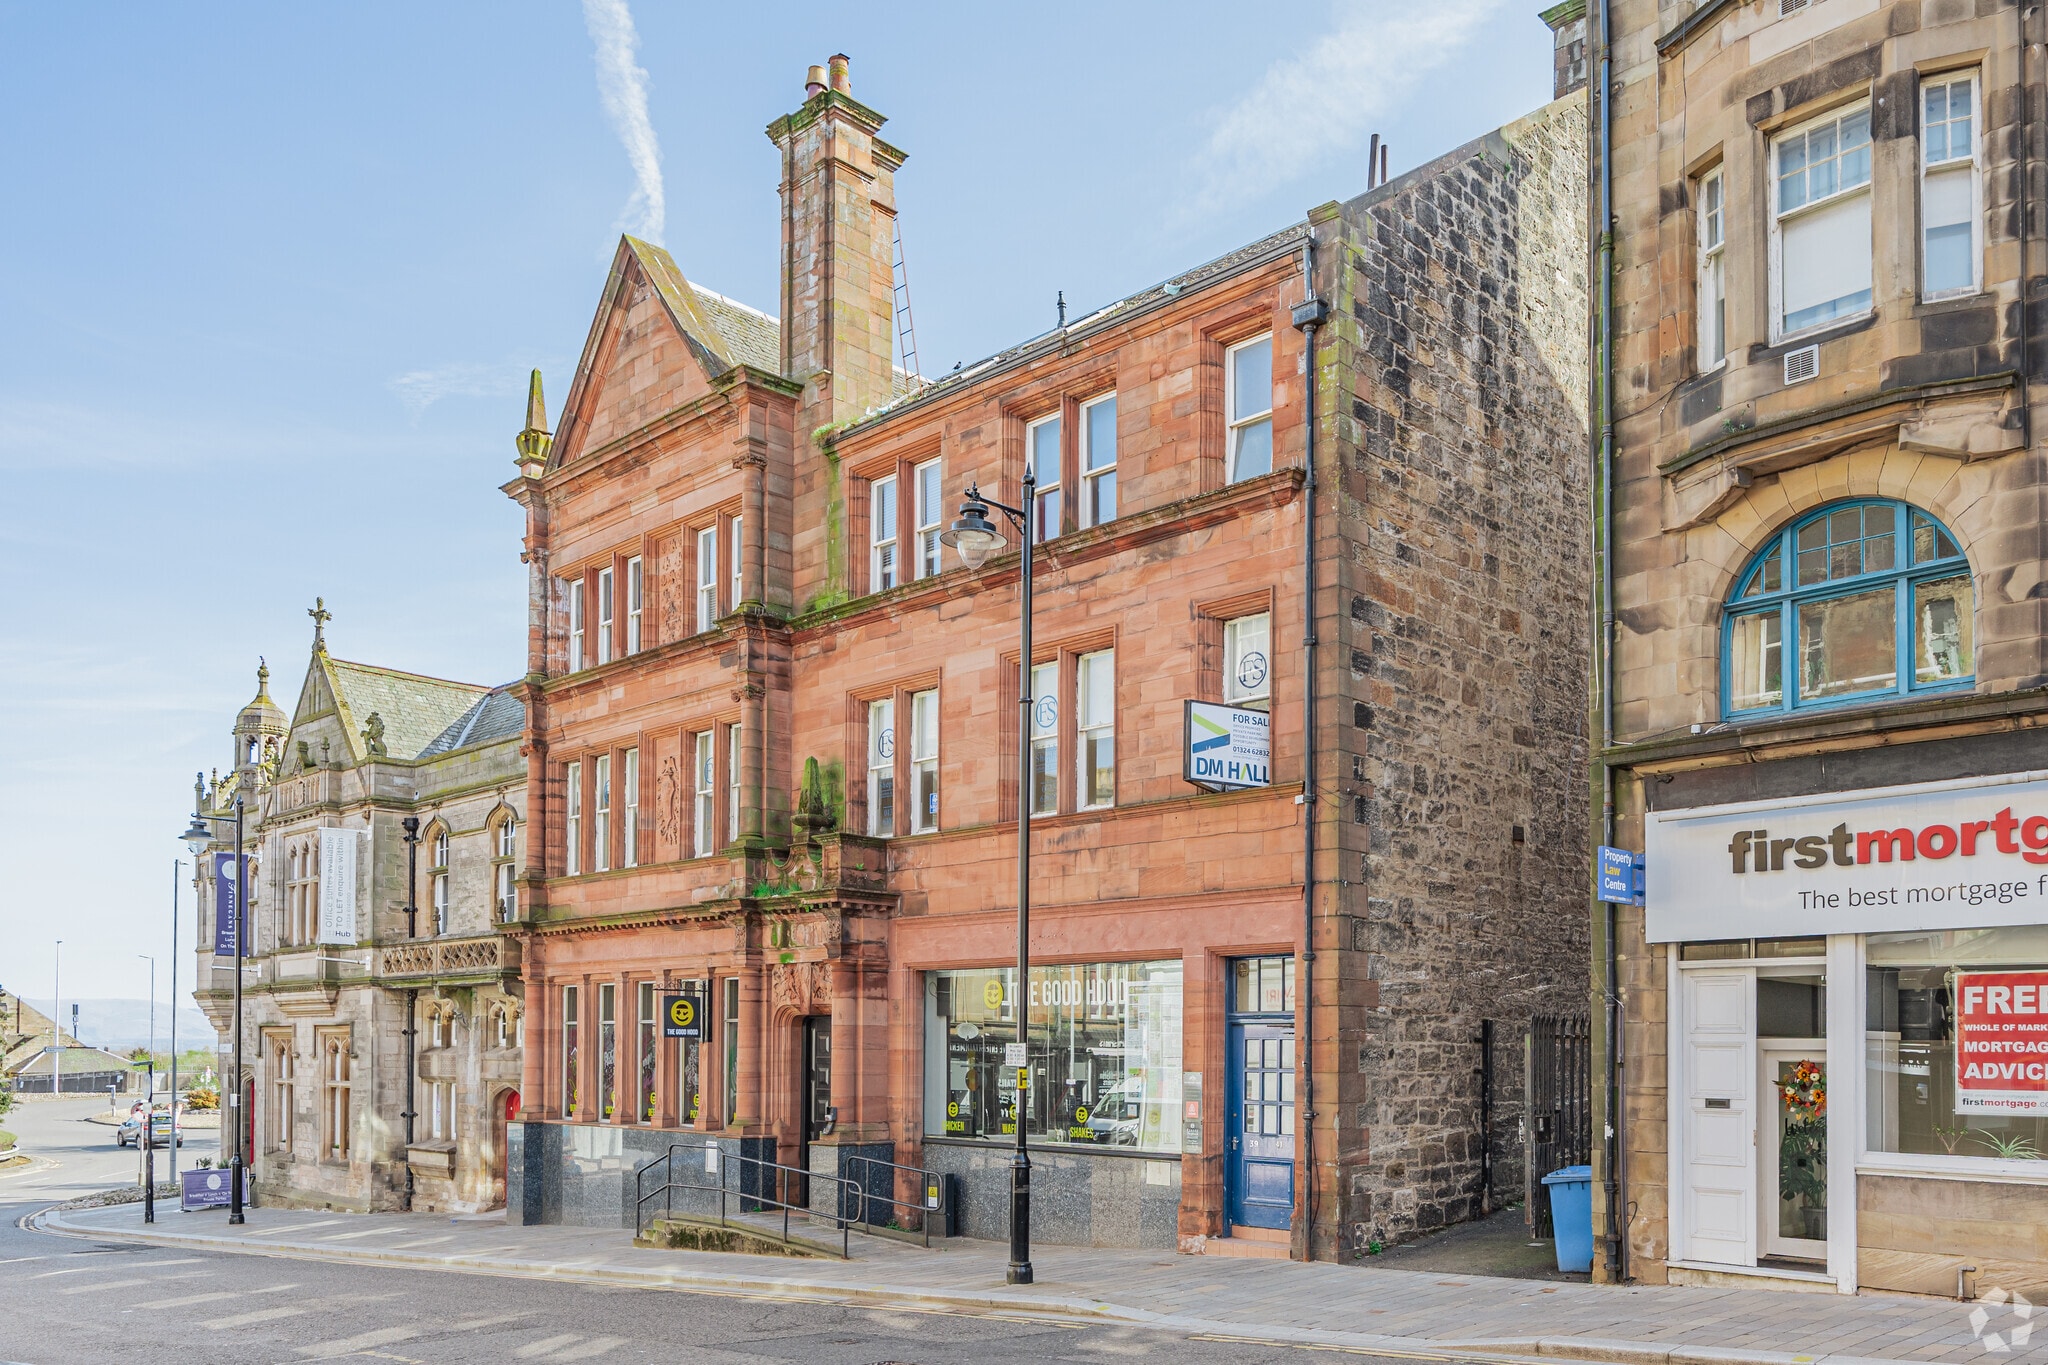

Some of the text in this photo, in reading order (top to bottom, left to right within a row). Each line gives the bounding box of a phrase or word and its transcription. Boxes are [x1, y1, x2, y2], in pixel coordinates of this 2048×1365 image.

[1233, 714, 1270, 727] FOR SAL
[1196, 757, 1270, 783] DM HALL
[1605, 849, 1632, 867] Property
[1605, 863, 1620, 876] Law
[1605, 877, 1626, 891] Centre
[1798, 890, 1840, 909] The
[1848, 887, 1898, 907] best
[1906, 881, 2028, 906] mortgage
[336, 916, 343, 928] TO
[1012, 980, 1039, 1007] TE
[1042, 980, 1083, 1006] GOOD
[1964, 1062, 2048, 1080] ADVIC
[1070, 1127, 1094, 1138] SHAKES
